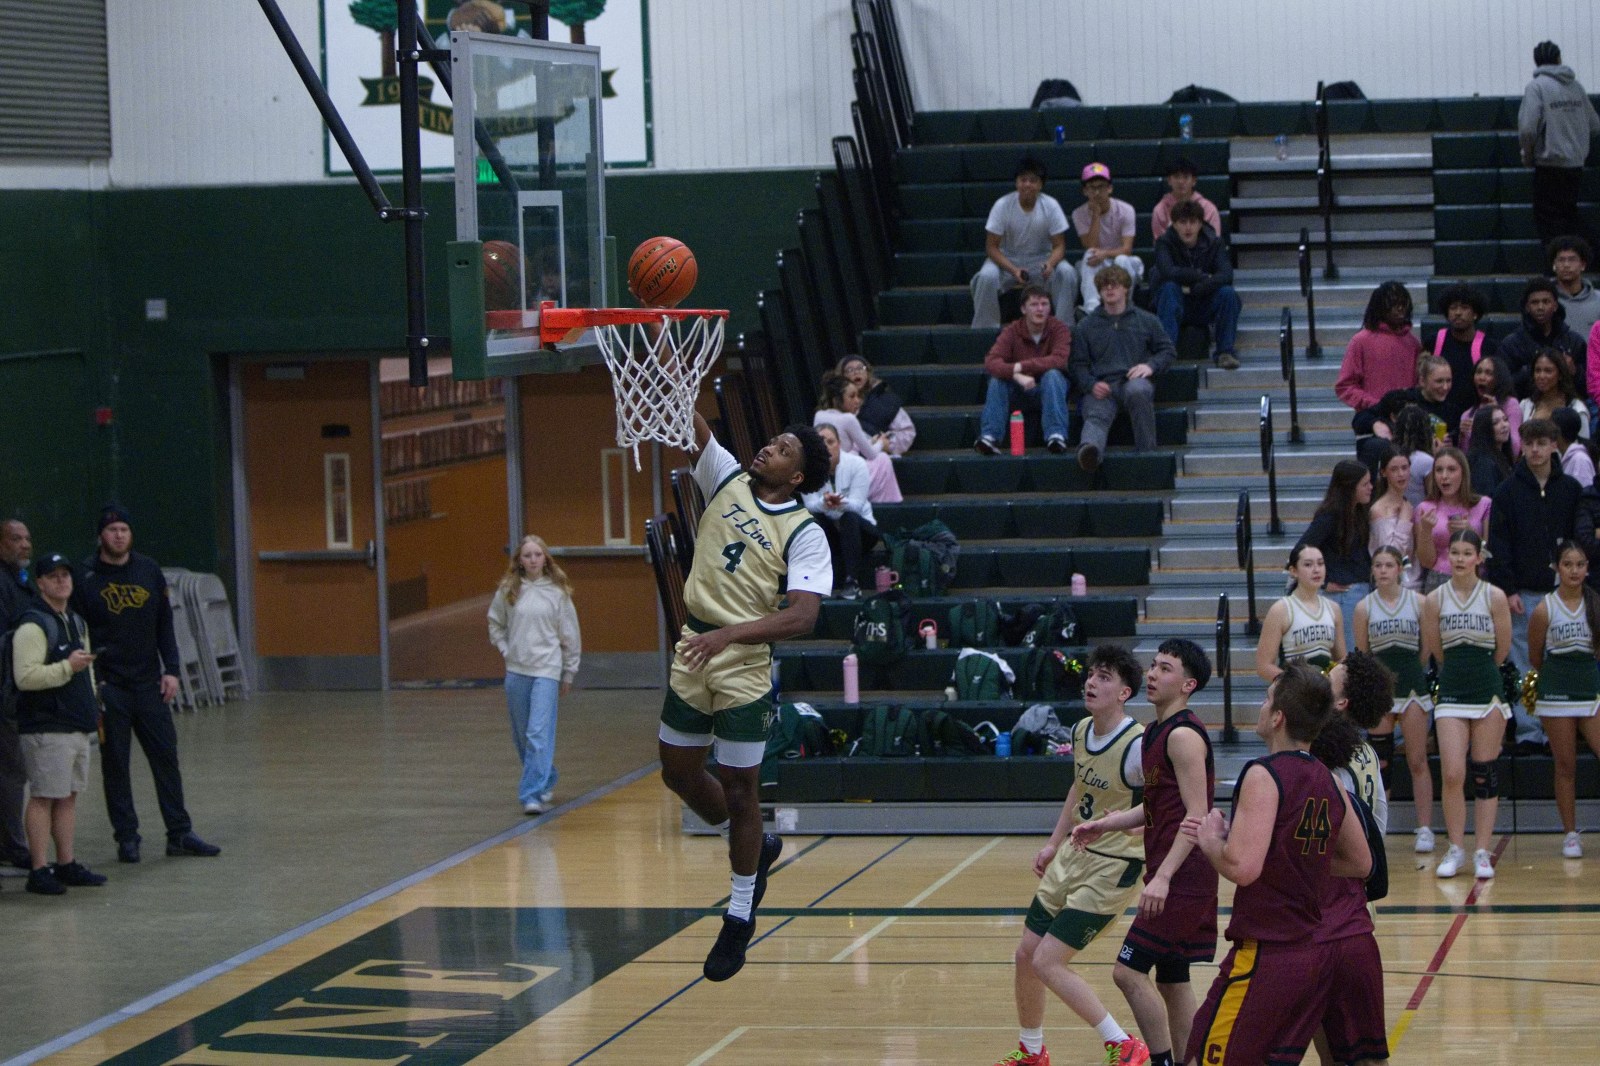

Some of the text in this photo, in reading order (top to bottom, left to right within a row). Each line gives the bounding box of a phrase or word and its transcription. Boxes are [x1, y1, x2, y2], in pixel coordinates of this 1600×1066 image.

[722, 504, 772, 550] T-Line
[722, 541, 747, 573] 4
[1079, 792, 1094, 820] 3
[1294, 797, 1332, 855] 44
[1207, 1043, 1222, 1065] C
